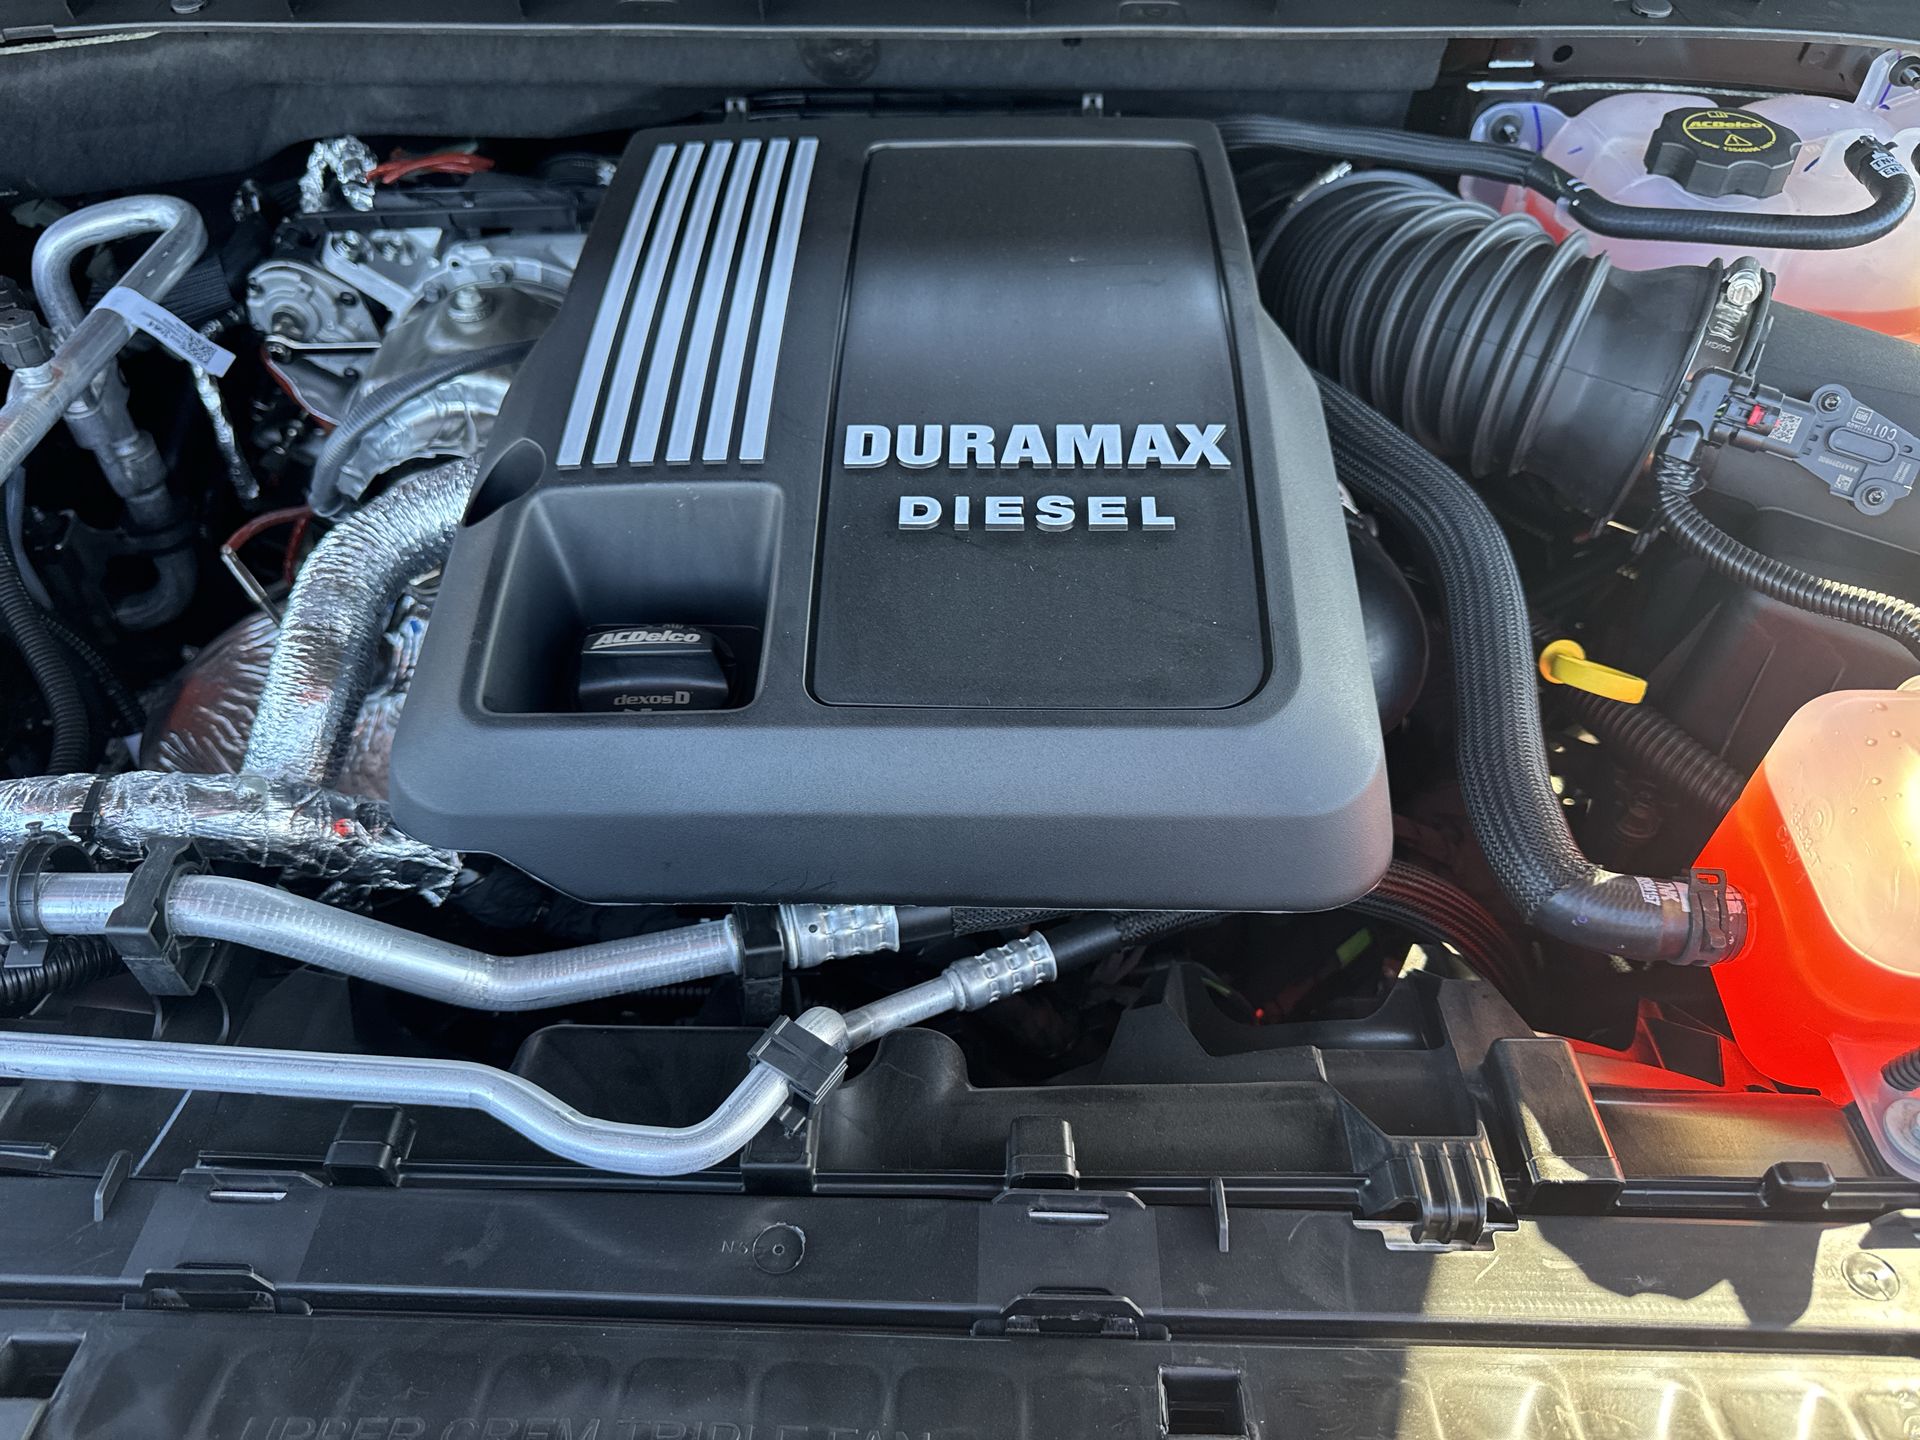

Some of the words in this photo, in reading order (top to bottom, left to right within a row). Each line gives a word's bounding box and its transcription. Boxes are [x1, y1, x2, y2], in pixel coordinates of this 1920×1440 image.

[1689, 121, 1763, 129] ACDelco
[843, 423, 1232, 470] DURAMAX
[898, 495, 1176, 531] DIESEL
[592, 629, 702, 647] ACDelco
